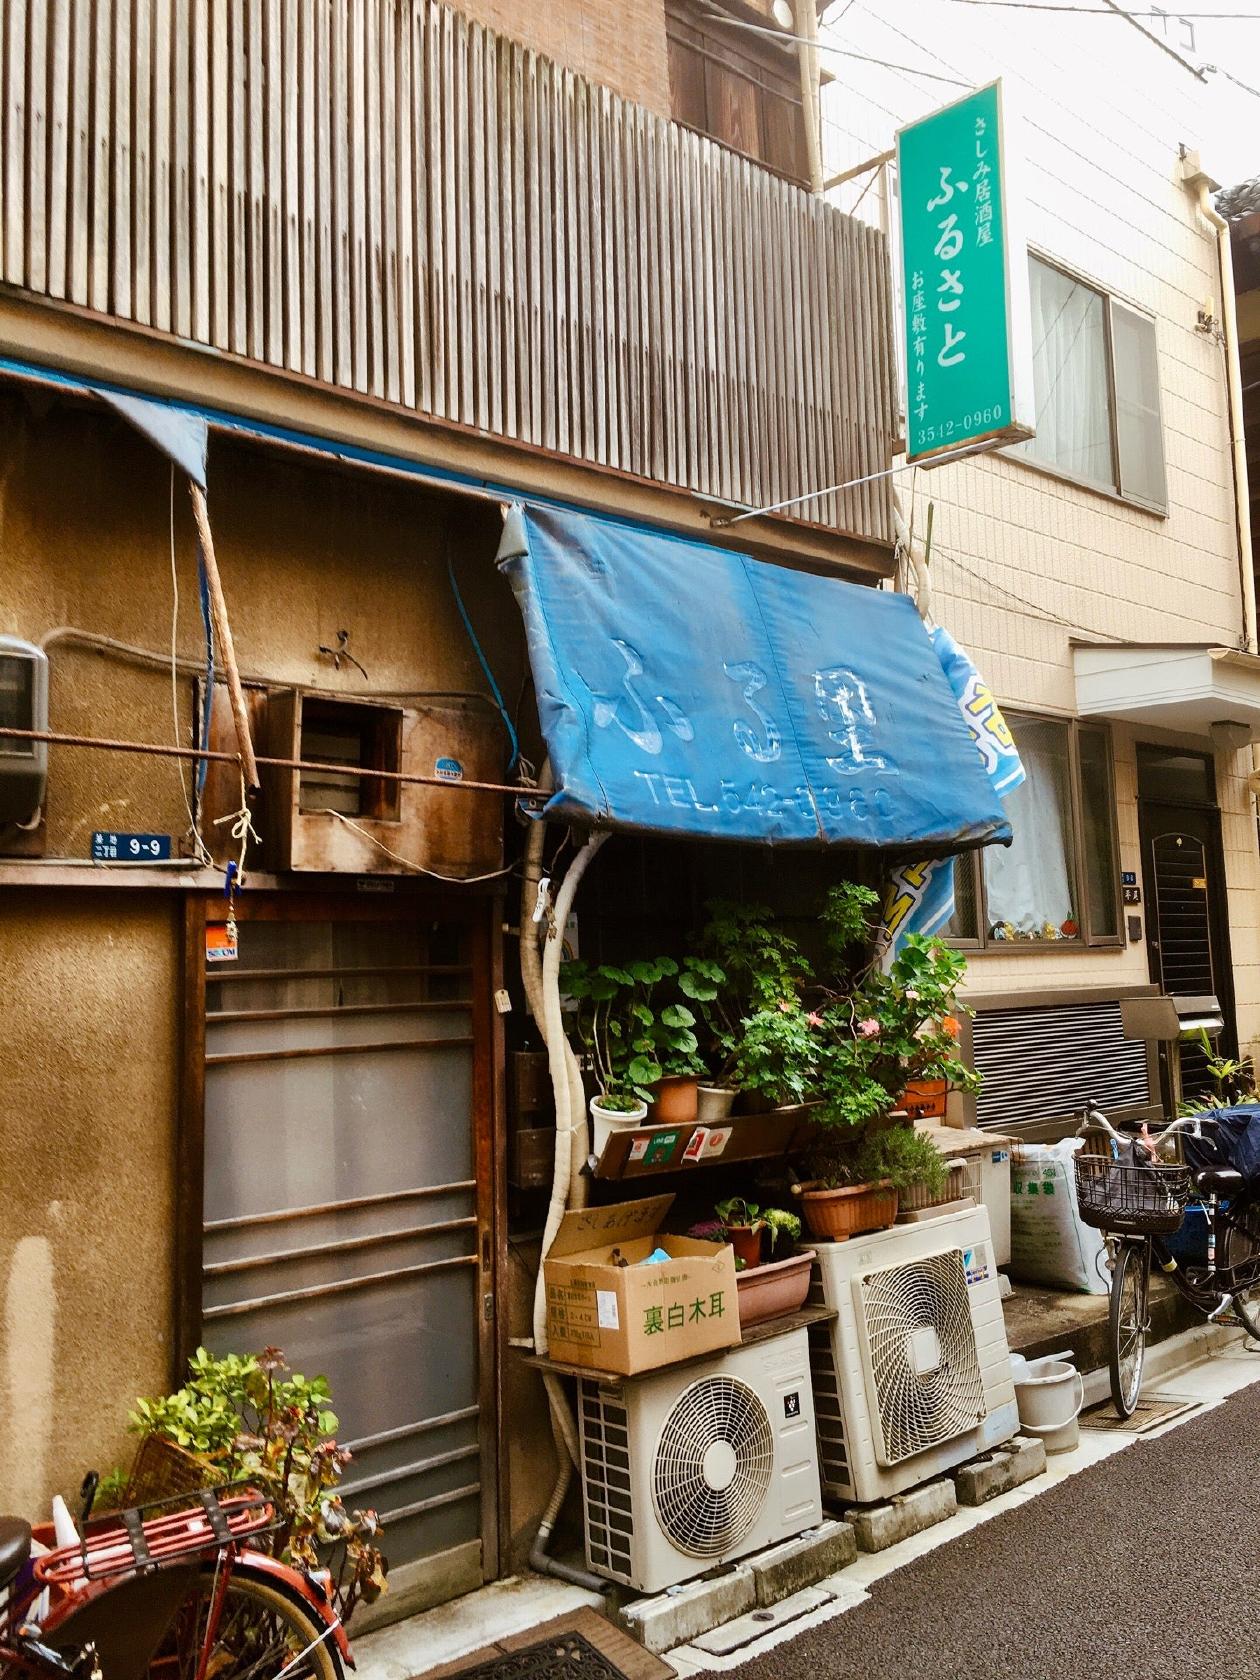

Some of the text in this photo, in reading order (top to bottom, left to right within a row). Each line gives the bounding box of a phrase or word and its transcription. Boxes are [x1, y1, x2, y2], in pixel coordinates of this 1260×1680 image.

[972, 116, 995, 248] さしみ居酒屋
[926, 166, 969, 368] ふるさと
[911, 270, 929, 423] お座敷有ります
[917, 402, 1003, 446] 3542-0960
[584, 637, 900, 777] ふる里
[129, 838, 161, 856] 9-9
[643, 1290, 726, 1336] 裏白木耳
